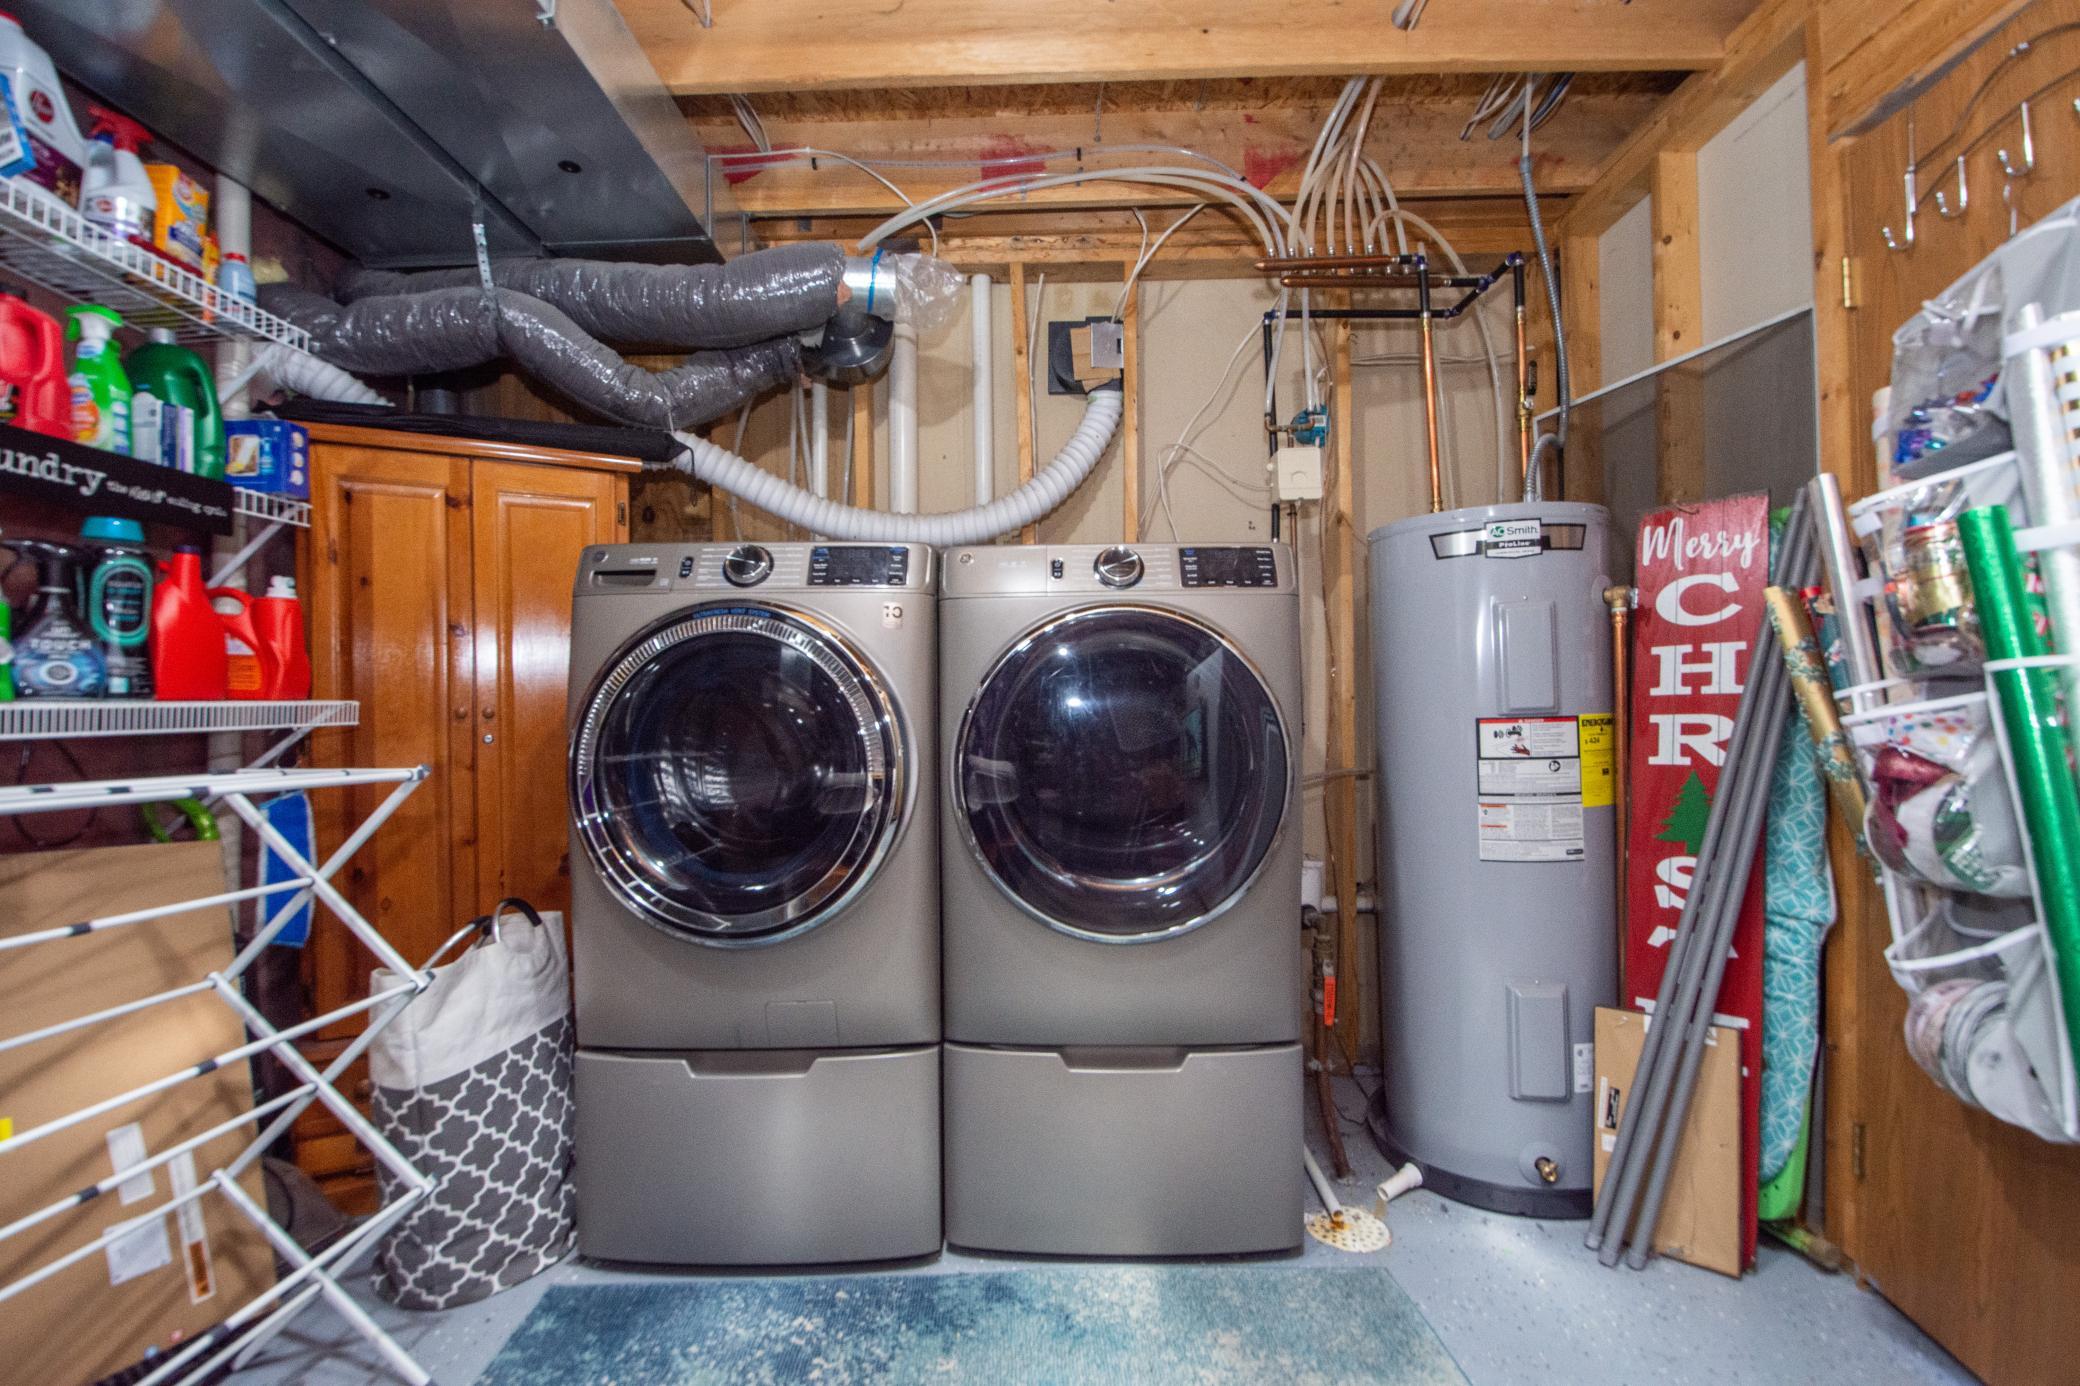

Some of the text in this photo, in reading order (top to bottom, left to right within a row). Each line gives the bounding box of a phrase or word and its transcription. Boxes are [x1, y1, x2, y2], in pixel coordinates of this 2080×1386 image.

[1506, 525, 1537, 536] Smith
[1498, 540, 1530, 549] ProLine
[1642, 516, 1760, 571] Merry
